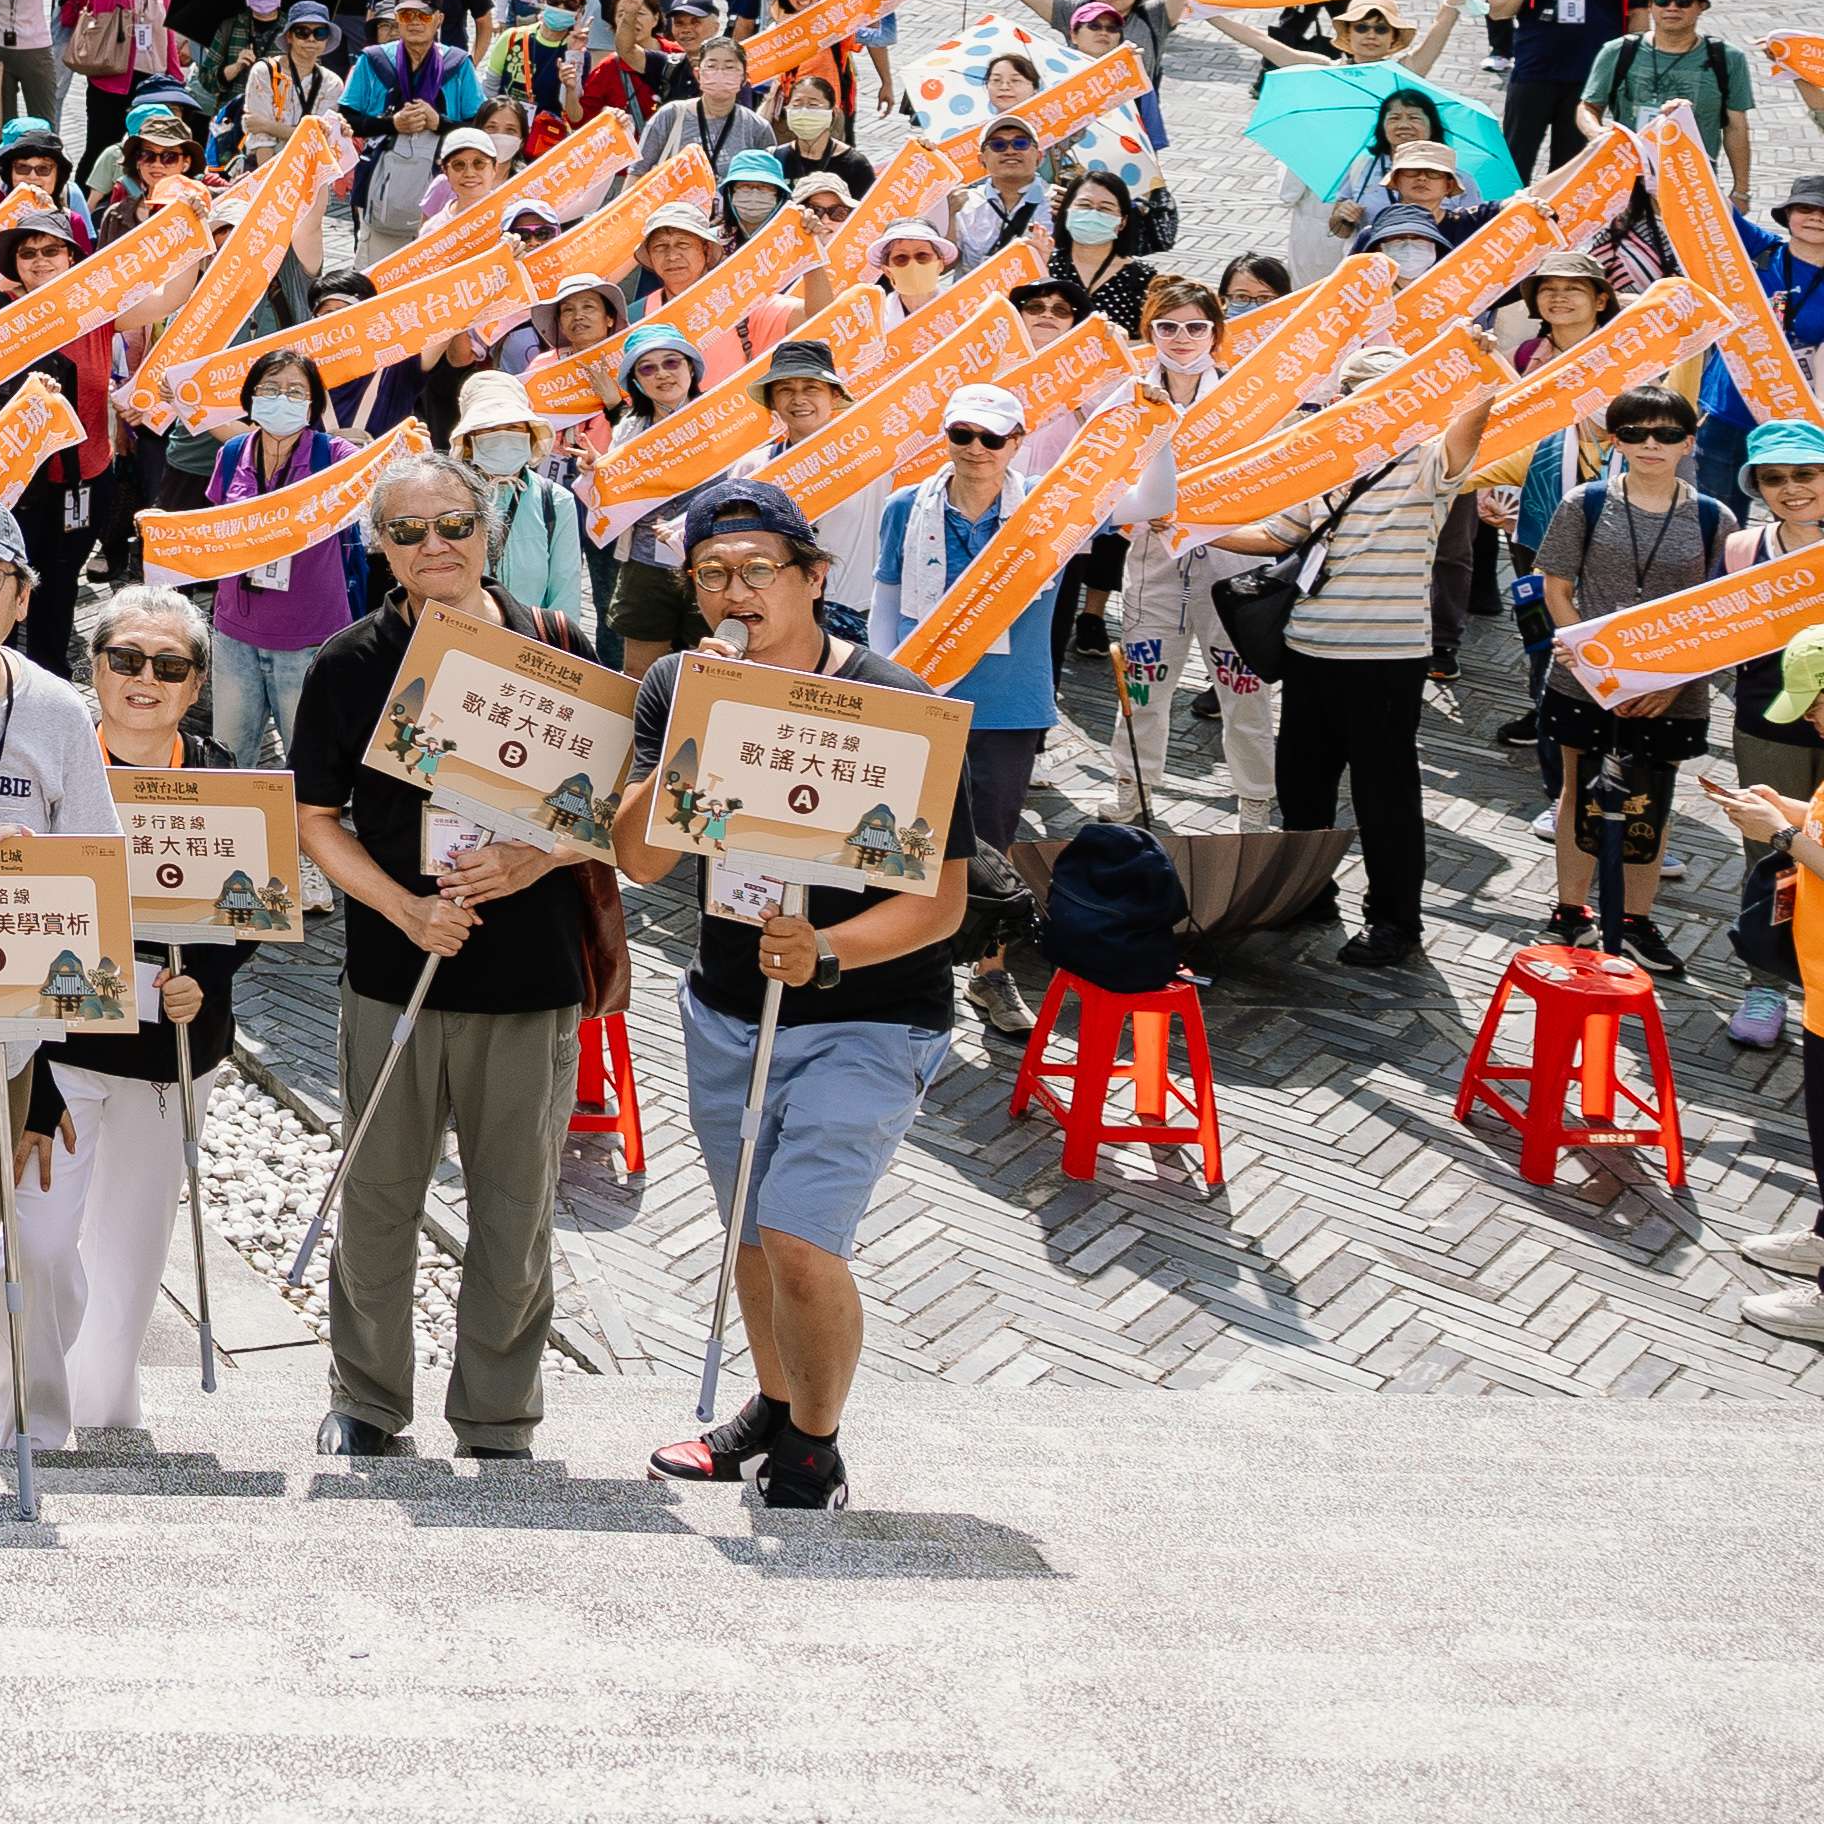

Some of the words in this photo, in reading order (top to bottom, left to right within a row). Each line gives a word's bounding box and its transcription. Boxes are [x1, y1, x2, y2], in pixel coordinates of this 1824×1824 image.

[65, 215, 195, 310] 尋寶台北城
[687, 224, 804, 333] 尋寶台北城
[1420, 214, 1538, 323] 尋寶台北城
[366, 264, 510, 343] 尋寶台北城
[1273, 261, 1395, 386] 尋寶台北城
[1554, 285, 1705, 392] 尋寶台北城
[1329, 347, 1482, 446] 尋寶台北城
[1021, 404, 1151, 538] 尋寶台北城
[1616, 568, 1816, 648] 2024年史蹟趴趴GO
[518, 652, 584, 686] 尋寶台北城
[499, 682, 575, 722] 步行路線
[789, 687, 863, 711] 尋寶台北城
[461, 690, 594, 760] 歌謠大稻埕
[777, 724, 860, 753] 步行路線
[505, 746, 521, 764] B
[739, 741, 887, 789] 歌謠大稻埕
[134, 781, 198, 794] 尋寶台北城
[792, 789, 814, 809] A
[131, 815, 206, 830] 步行路線
[132, 835, 236, 858] 謠大稻埕
[162, 867, 178, 884] C
